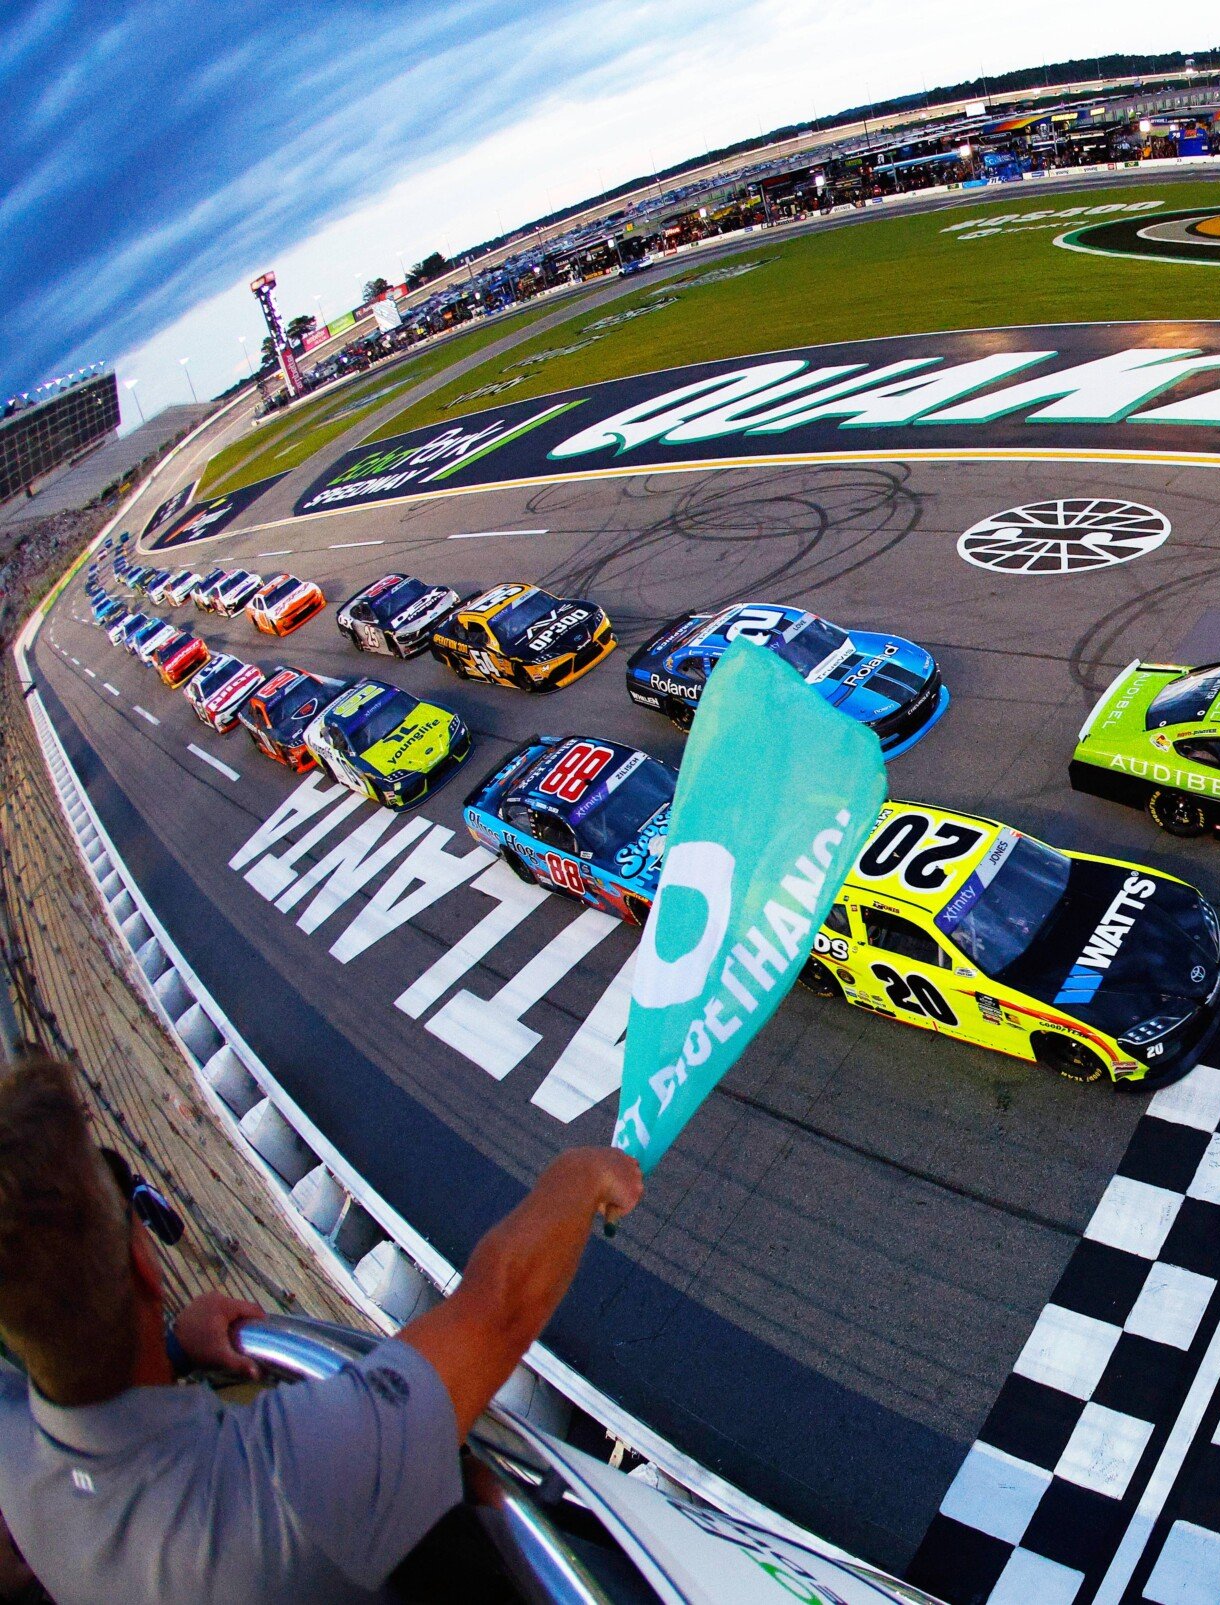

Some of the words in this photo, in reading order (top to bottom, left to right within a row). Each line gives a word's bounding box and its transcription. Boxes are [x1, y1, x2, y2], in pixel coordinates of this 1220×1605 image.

[325, 418, 505, 487] EchoPark
[302, 467, 429, 511] SPEEDWAY
[390, 587, 440, 629] DEX
[792, 618, 807, 632] LOVE
[364, 624, 380, 649] 25
[528, 608, 590, 652] OP300
[469, 649, 501, 679] 54
[844, 643, 899, 687] Roland
[650, 674, 700, 700] Roland
[1100, 671, 1153, 730] AUDIBEL
[387, 718, 441, 765] younglife
[539, 742, 615, 803] 88
[615, 756, 640, 781] ZILISCH
[575, 791, 604, 819] xfinity
[501, 829, 540, 866] Hog
[615, 824, 658, 880] Stay
[858, 813, 985, 890] 20
[988, 841, 1009, 866] JONES
[545, 851, 587, 895] 88
[942, 885, 978, 923] xfinity
[1076, 875, 1157, 969] WATTS
[870, 961, 959, 1028] 20
[1038, 1020, 1089, 1039] GOODYEAR
[1146, 1042, 1164, 1059] 20
